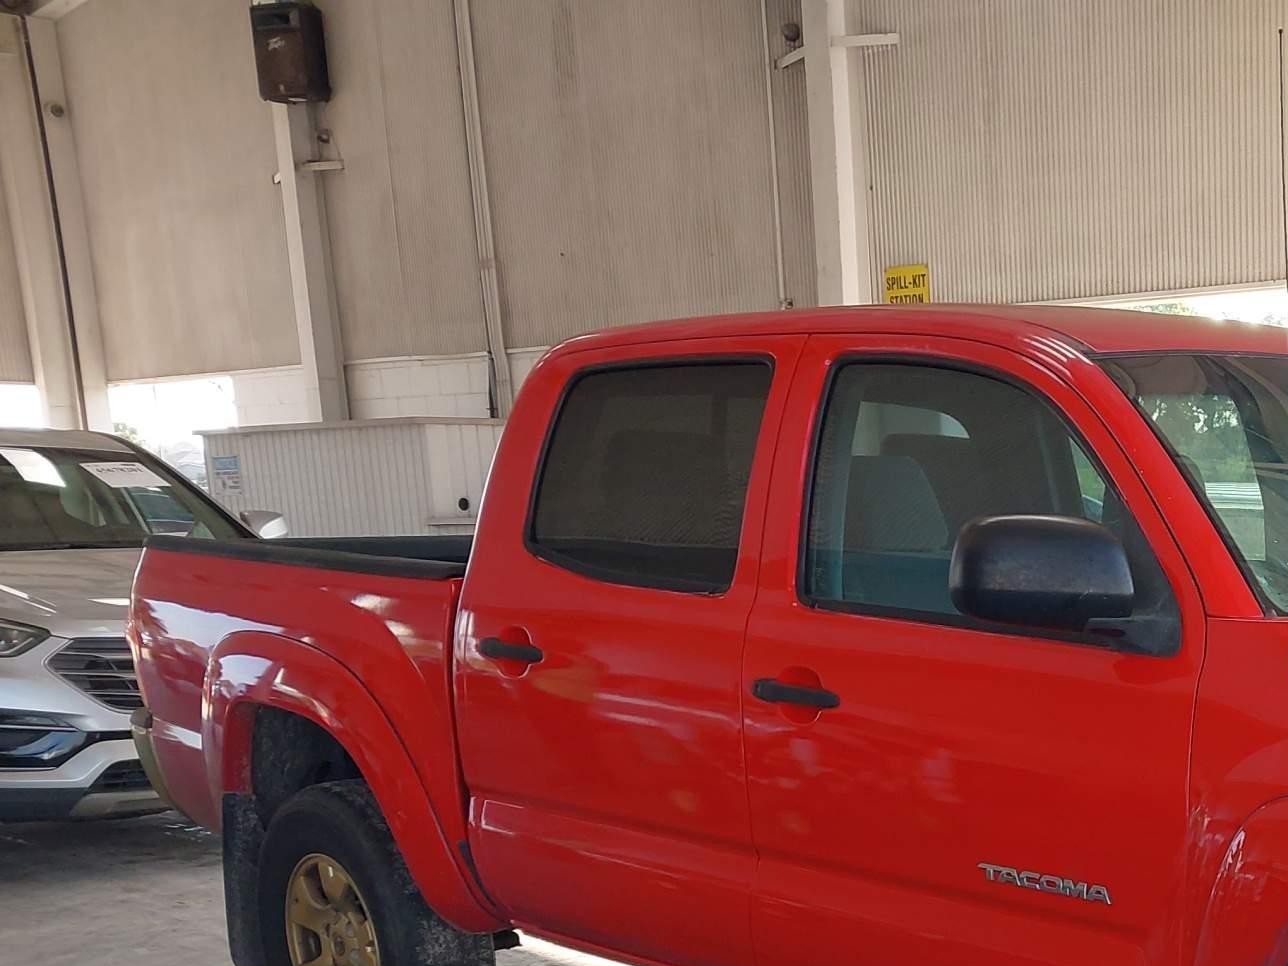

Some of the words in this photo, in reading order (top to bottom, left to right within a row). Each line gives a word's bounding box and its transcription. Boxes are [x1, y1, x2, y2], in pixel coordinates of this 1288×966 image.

[886, 273, 926, 290] SPILL-KIT
[889, 293, 923, 304] STATION
[977, 862, 1112, 905] TACOMA
